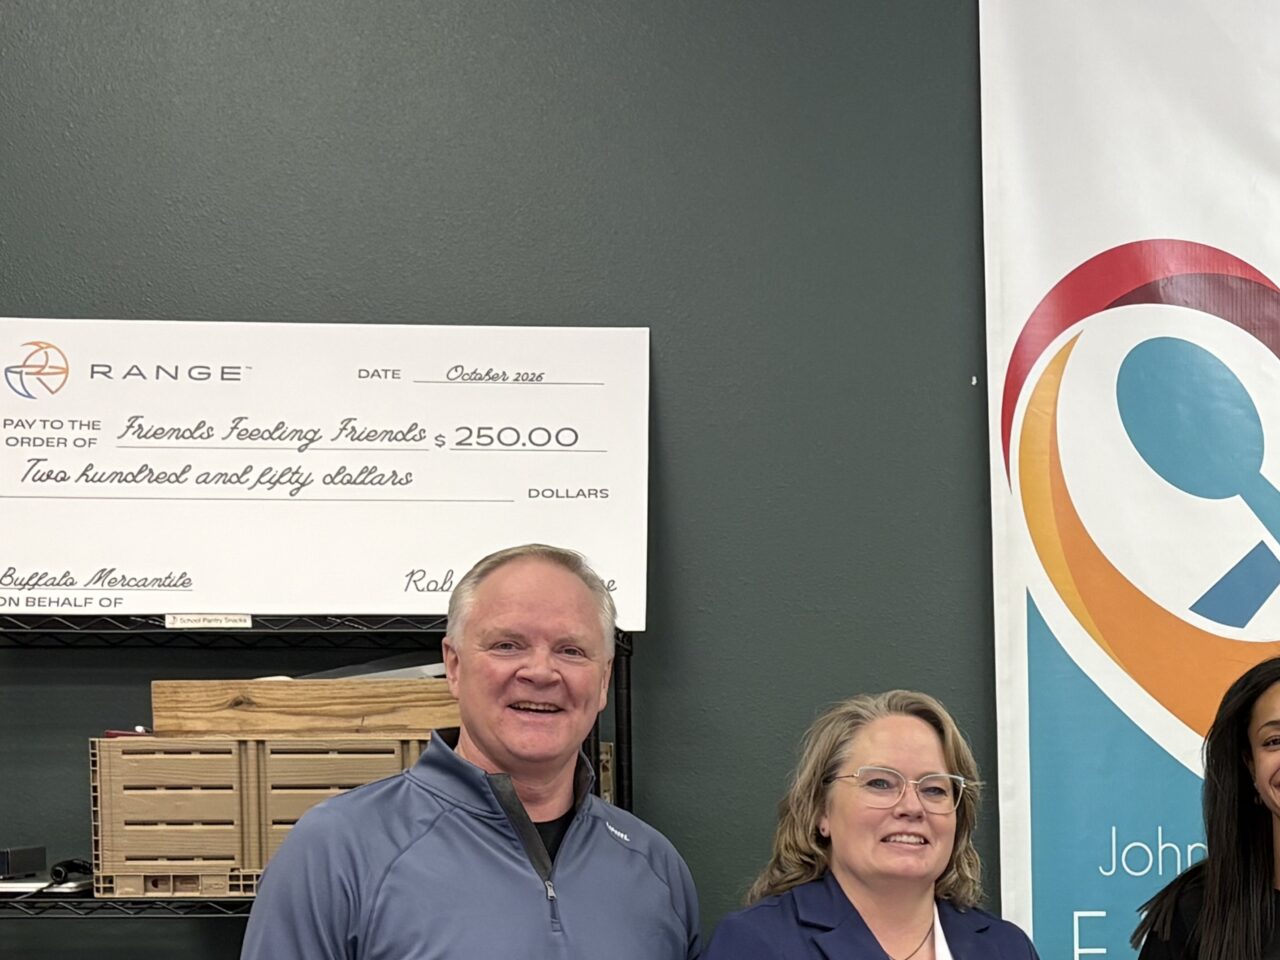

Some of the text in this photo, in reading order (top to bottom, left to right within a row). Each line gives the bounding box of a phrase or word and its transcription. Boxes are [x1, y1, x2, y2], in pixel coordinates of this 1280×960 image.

[90, 363, 242, 381] RANGE
[358, 364, 545, 382] DATE October 2026
[3, 418, 101, 431] PAY TO THE
[5, 437, 98, 448] ORDER OF
[116, 415, 215, 440] Friends
[221, 416, 323, 453] Feeding
[330, 417, 427, 443] Friends
[21, 458, 414, 497] Two hundred and fifty dollars
[528, 488, 610, 499] DOLLARS
[0, 566, 193, 591] Buffalo Mercantile
[25, 596, 94, 608] BEHALF
[98, 596, 124, 608] OF
